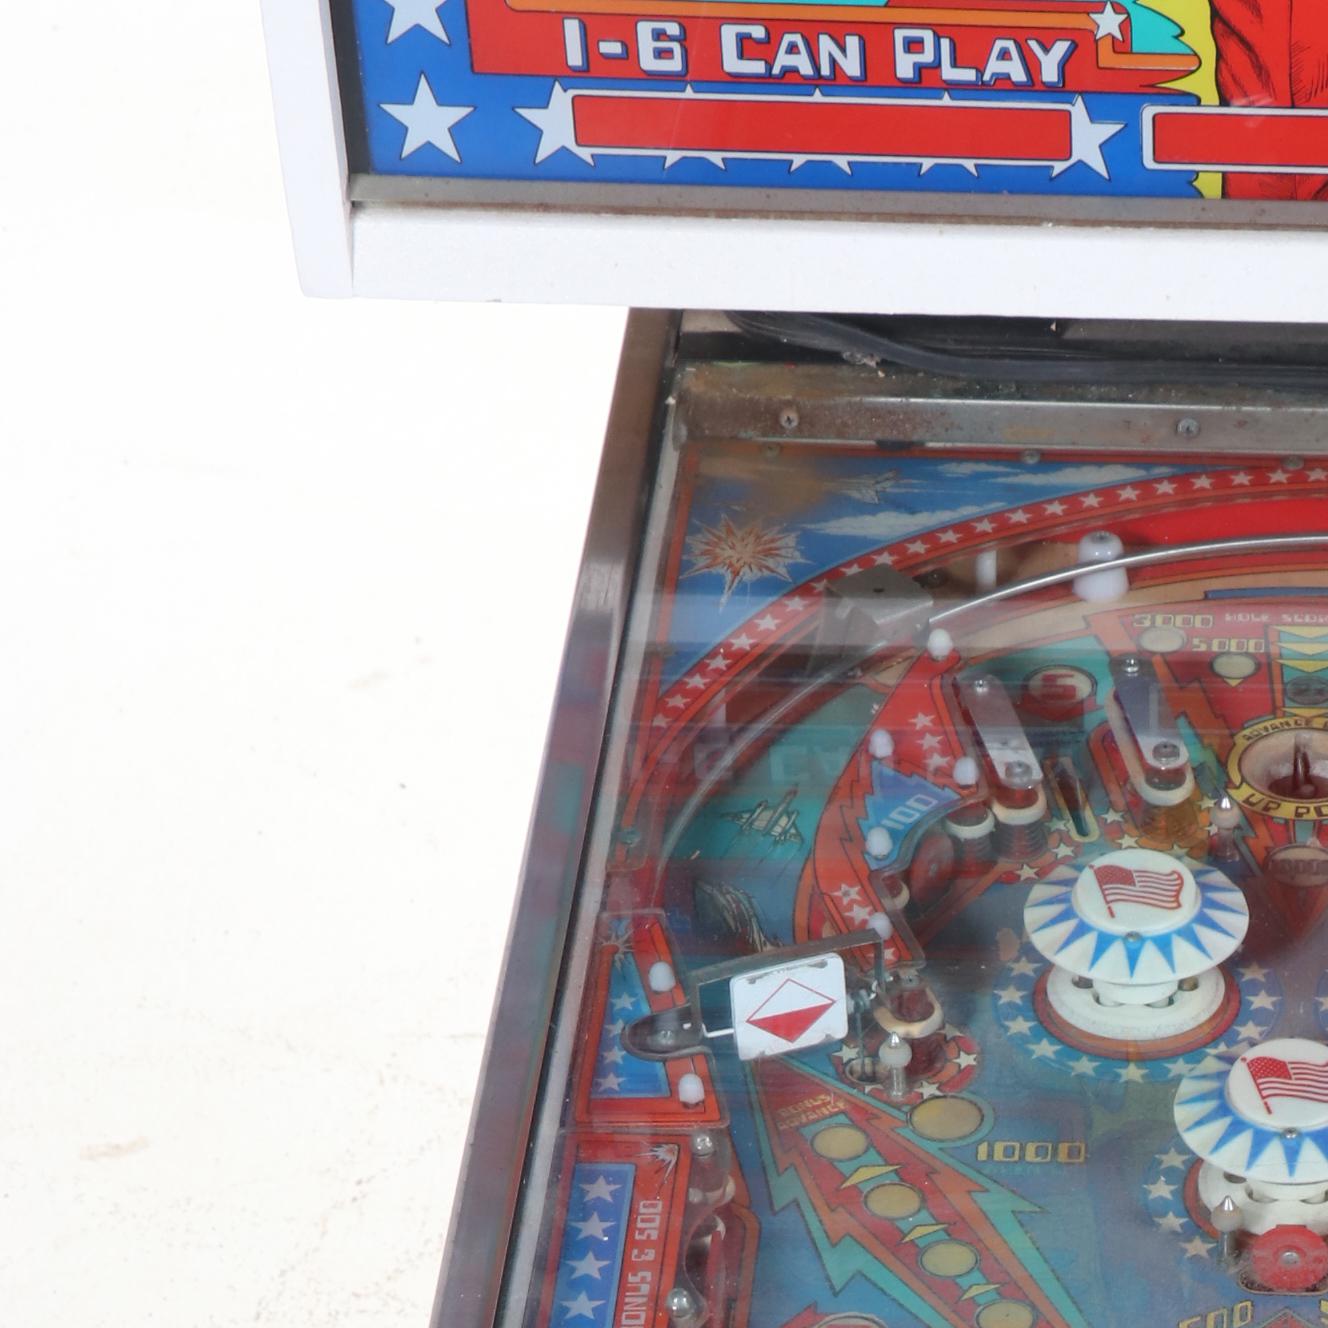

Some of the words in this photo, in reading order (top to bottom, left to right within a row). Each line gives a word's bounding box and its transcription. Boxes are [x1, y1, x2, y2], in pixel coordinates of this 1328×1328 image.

[1191, 637, 1265, 654] 5000
[881, 793, 938, 831] 100
[1244, 793, 1280, 812] UP
[976, 1141, 1086, 1163] 1000
[635, 1200, 663, 1240] 500
